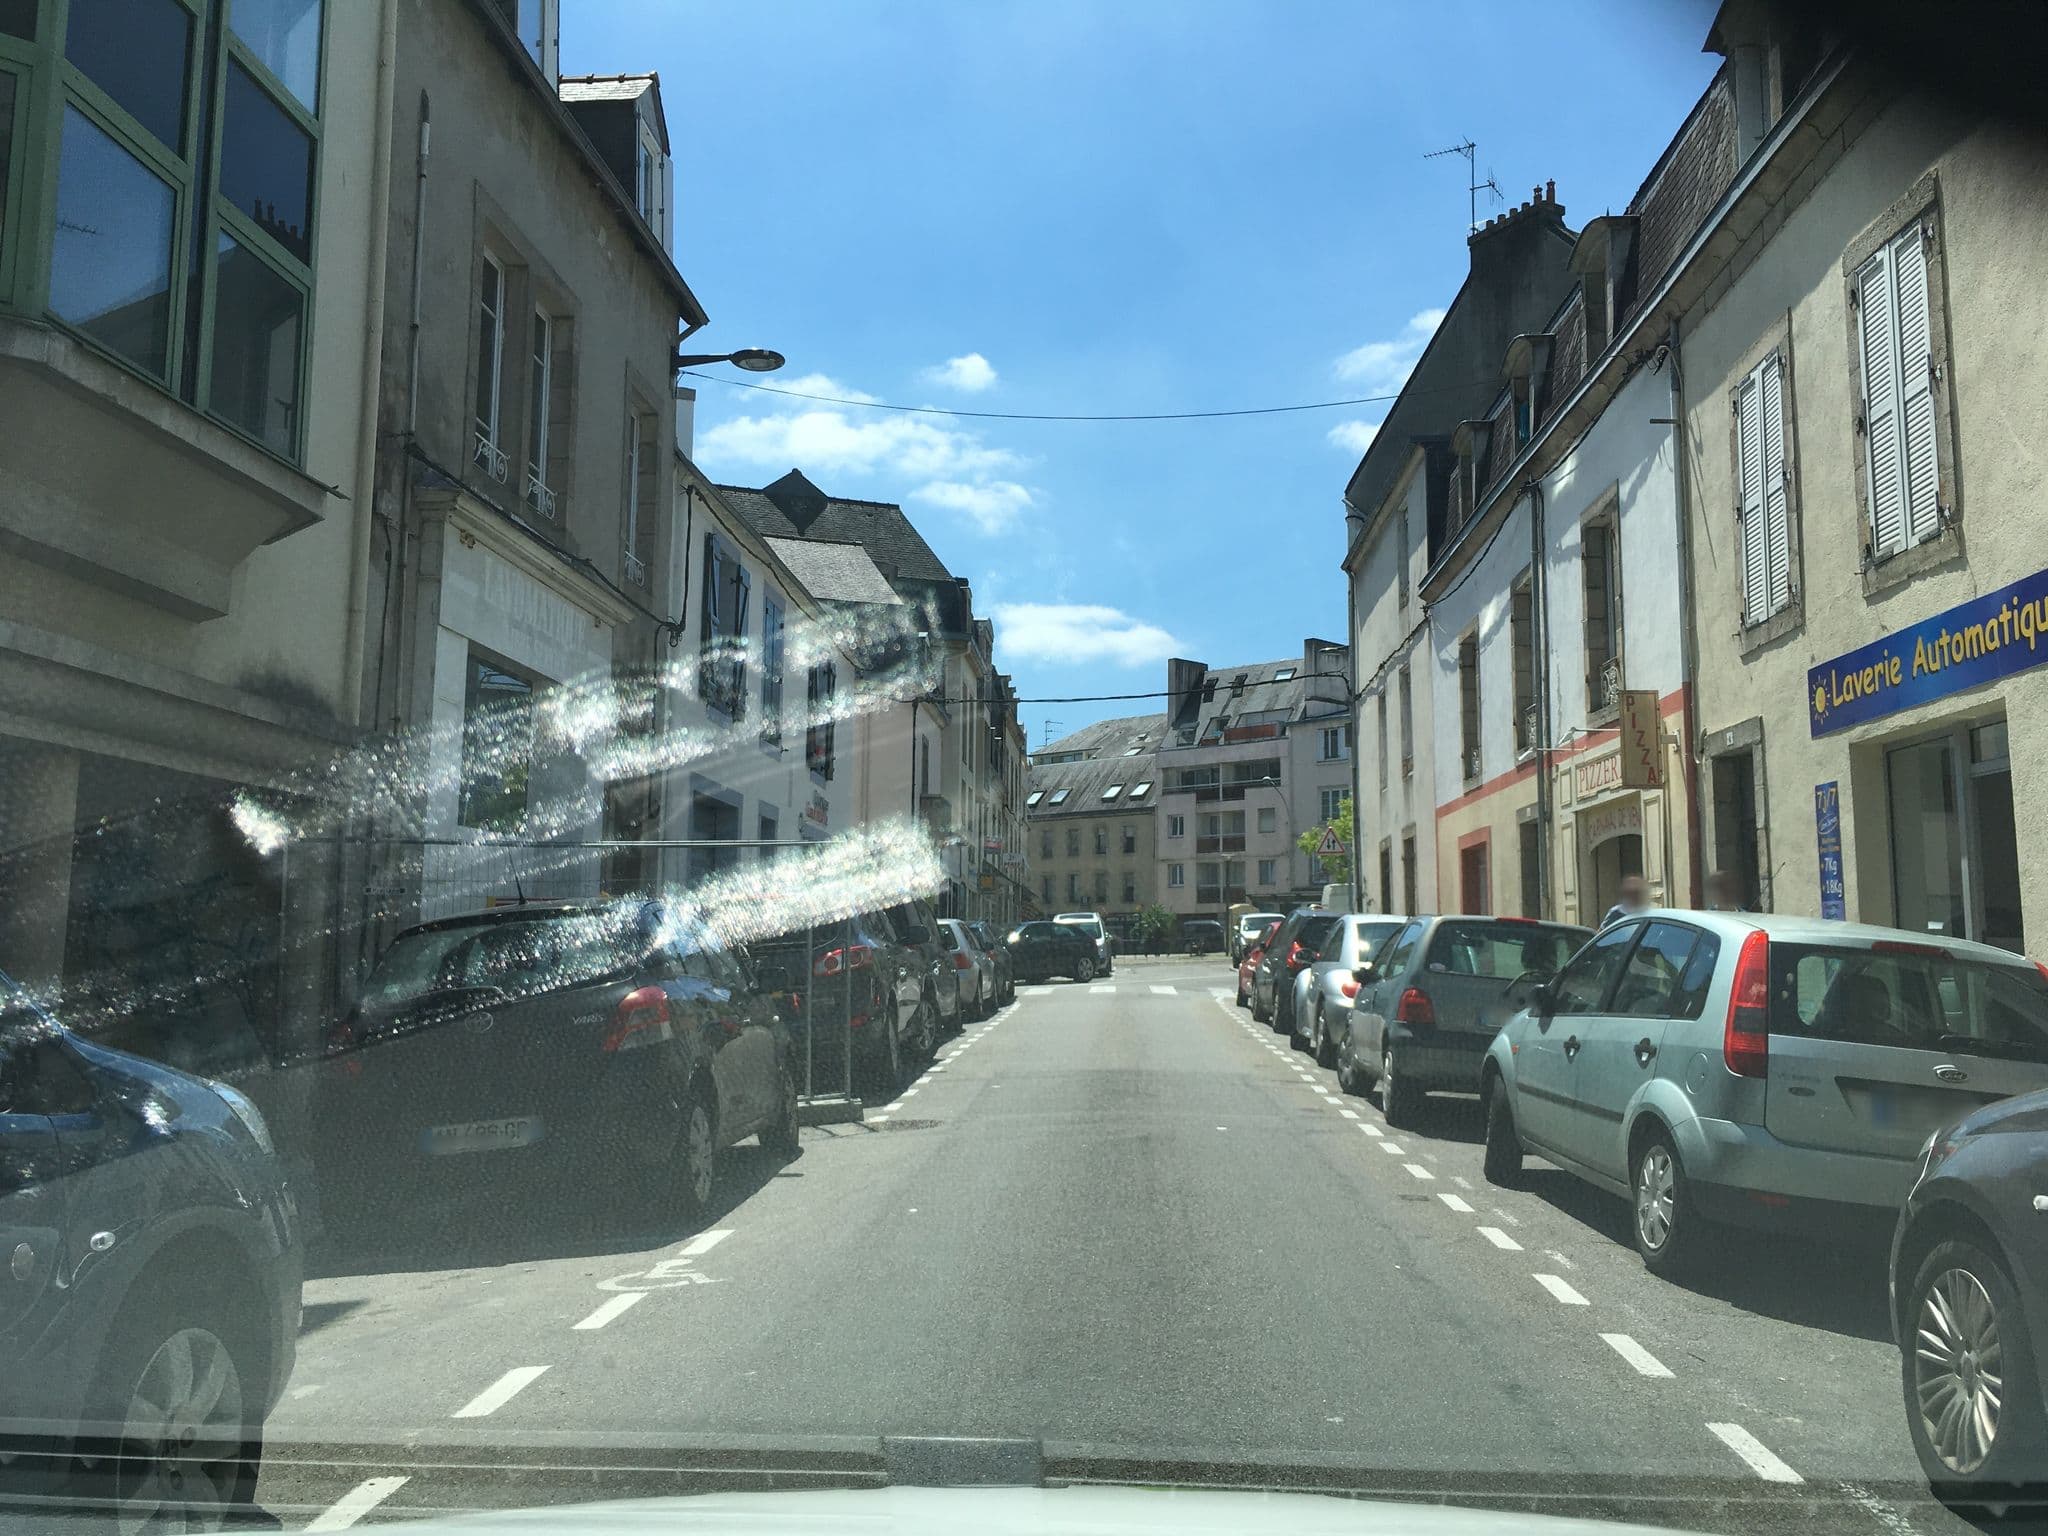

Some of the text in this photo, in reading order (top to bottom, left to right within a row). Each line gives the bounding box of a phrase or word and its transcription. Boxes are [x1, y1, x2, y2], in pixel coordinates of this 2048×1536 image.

[1832, 649, 1902, 707] Laverie
[1626, 695, 1657, 784] PIZZA
[1579, 758, 1621, 792] PIZZER
